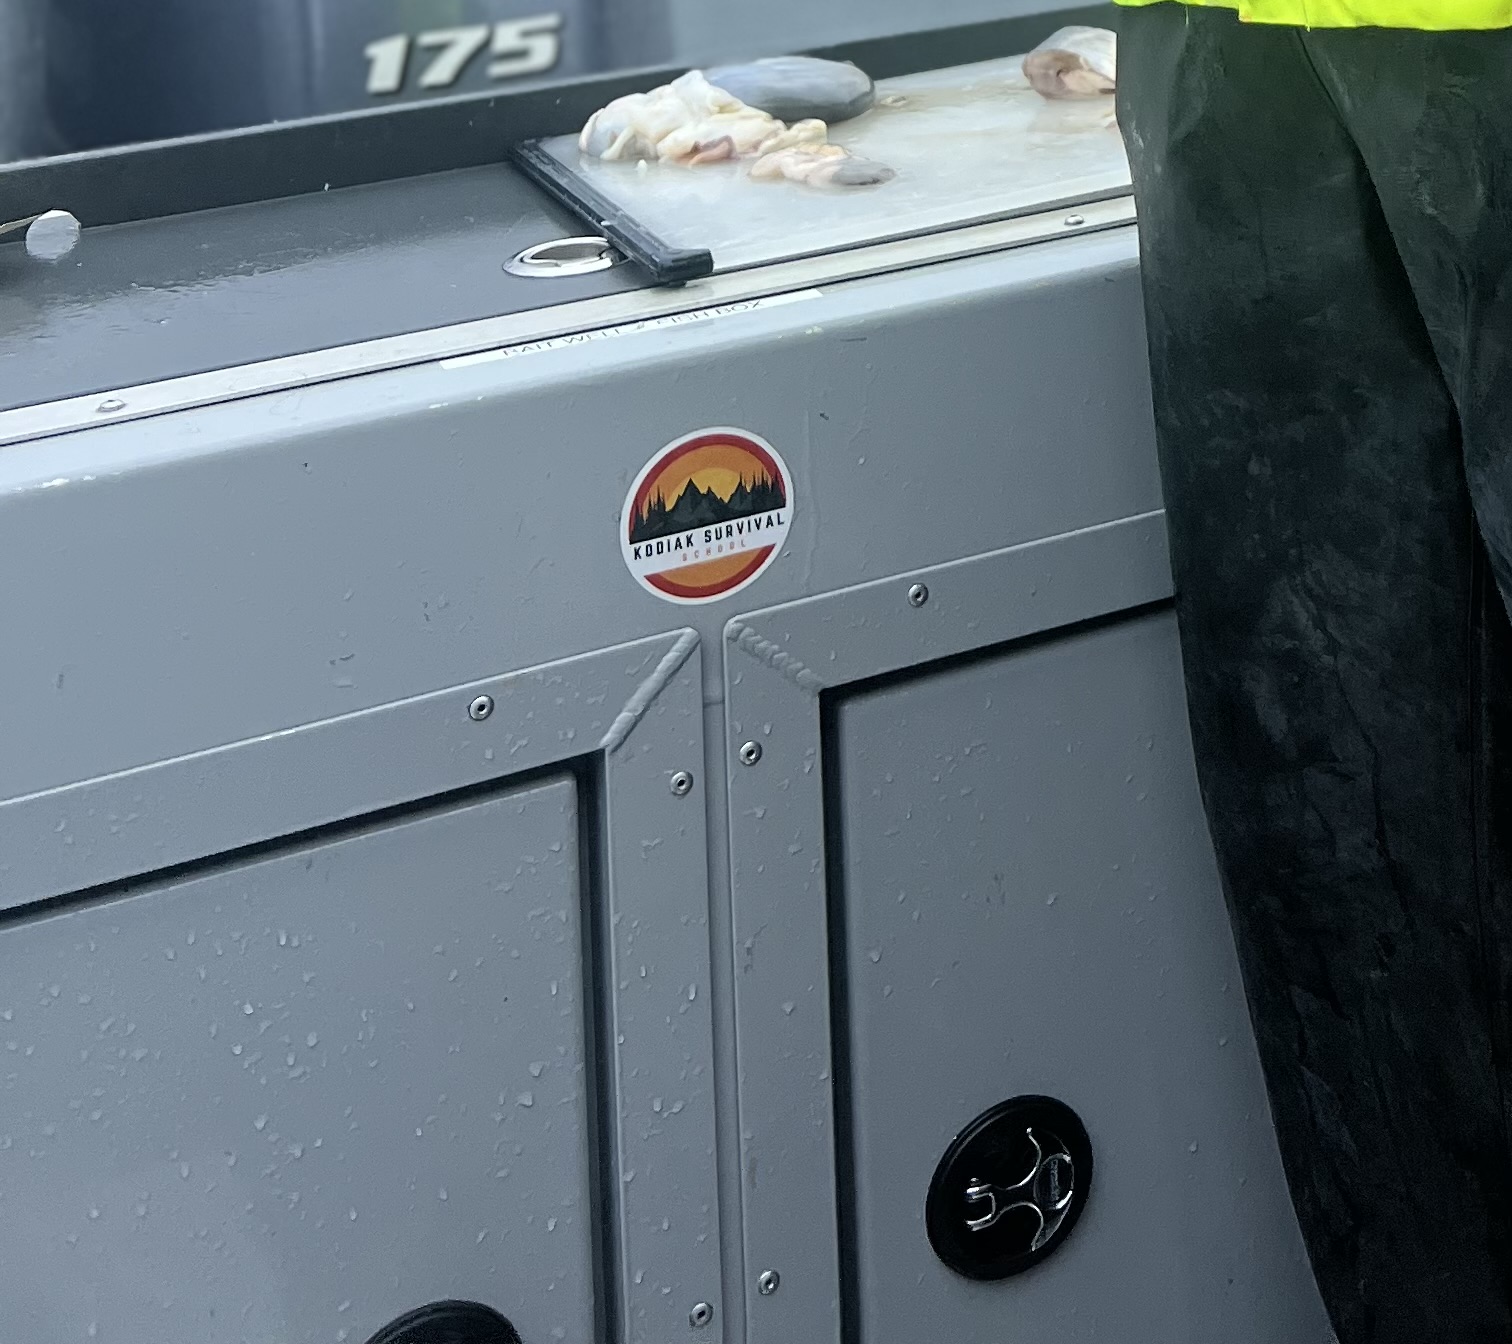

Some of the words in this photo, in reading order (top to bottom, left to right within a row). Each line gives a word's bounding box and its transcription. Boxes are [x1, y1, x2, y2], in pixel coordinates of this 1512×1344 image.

[364, 12, 561, 94] 175
[715, 299, 765, 315] BOX
[633, 533, 694, 561] KODIAK
[704, 512, 785, 543] SURVIVAL
[682, 539, 746, 562] SCHOOL
